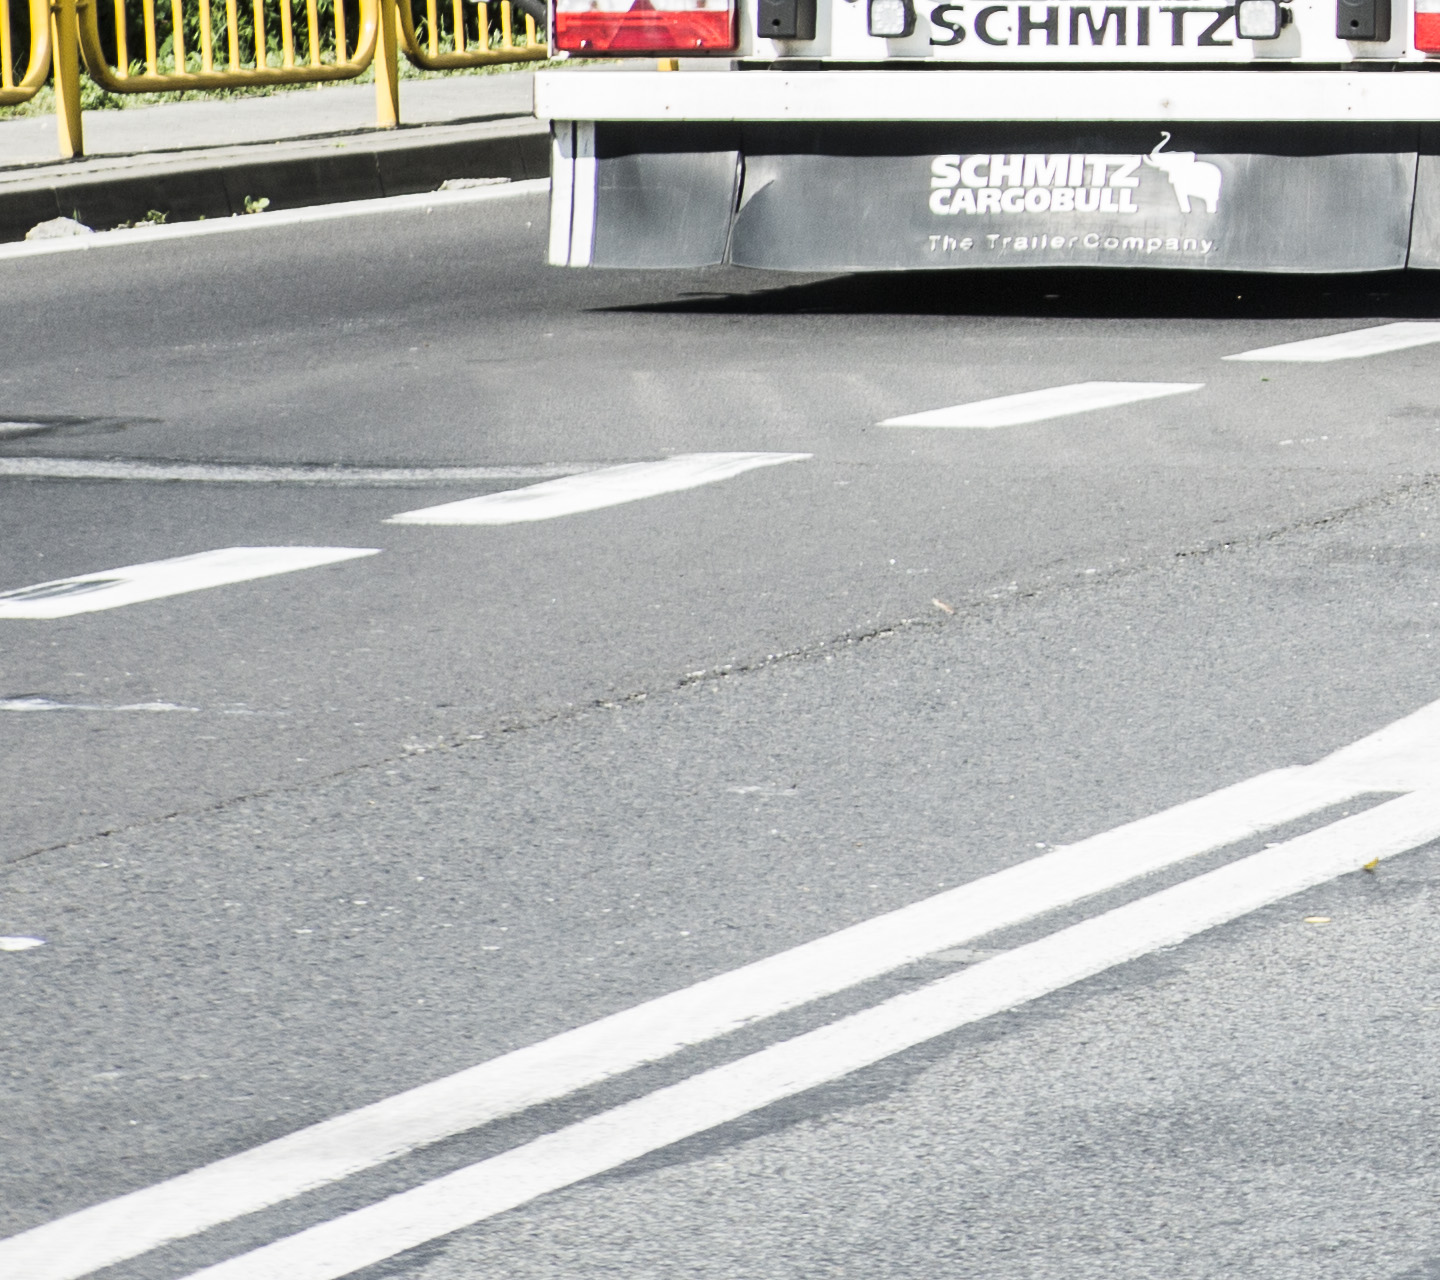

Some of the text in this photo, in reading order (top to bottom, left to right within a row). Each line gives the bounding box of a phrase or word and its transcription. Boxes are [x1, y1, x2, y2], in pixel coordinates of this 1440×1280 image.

[929, 4, 1237, 46] SCHMITZ
[930, 154, 1143, 188] SCHMITZ
[929, 187, 1139, 215] CARGOBULL
[929, 235, 973, 252] The
[986, 233, 1081, 251] Trailer
